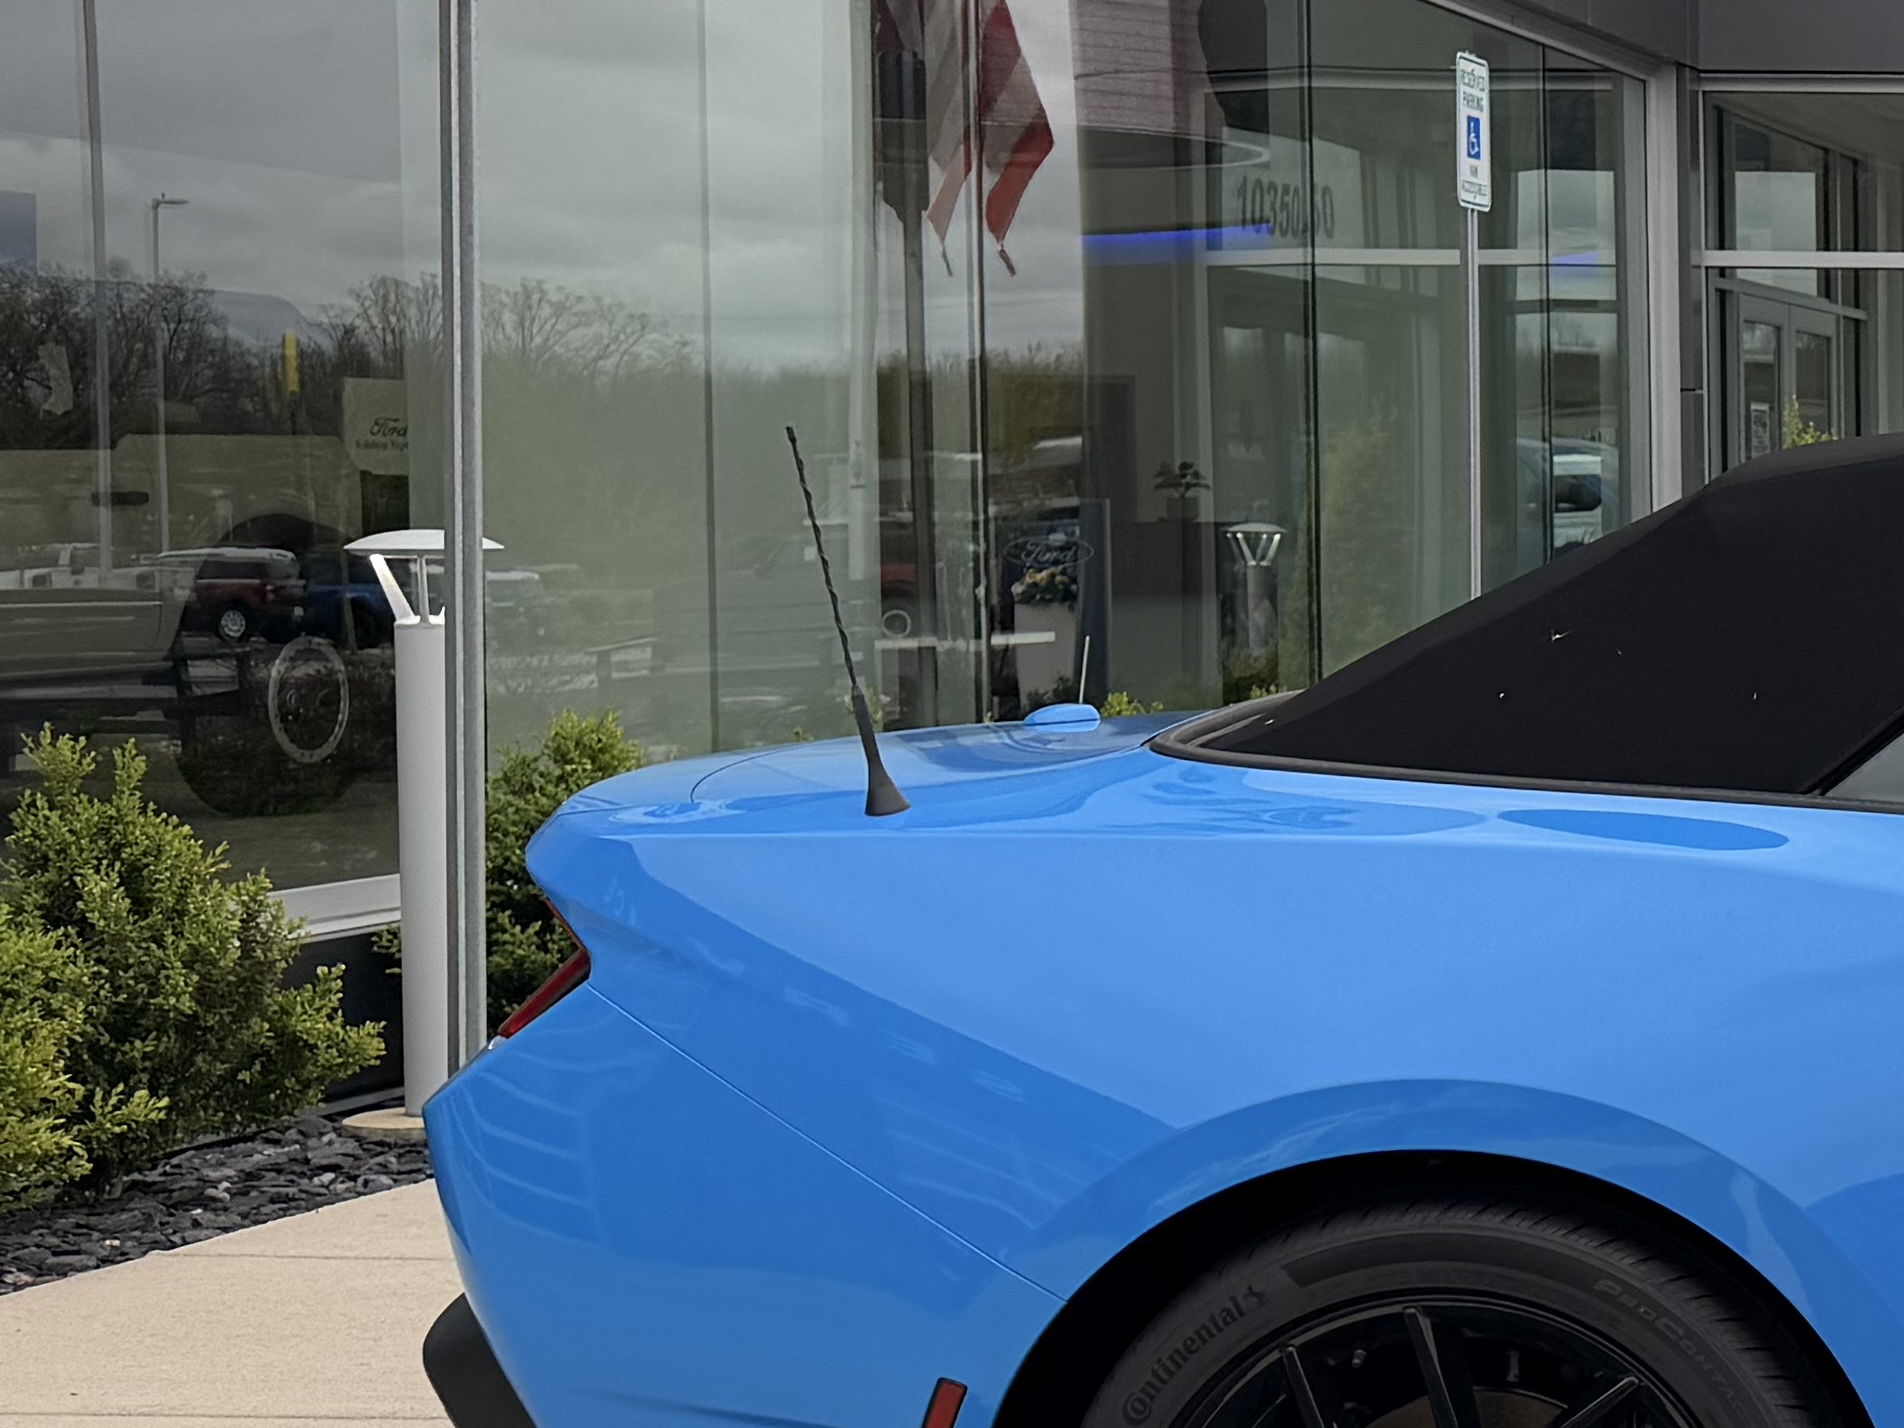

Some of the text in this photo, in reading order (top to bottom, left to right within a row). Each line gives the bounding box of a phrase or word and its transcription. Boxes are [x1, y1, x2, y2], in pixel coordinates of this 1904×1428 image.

[369, 417, 408, 437] Ford
[1020, 540, 1076, 562] Ford
[1121, 1294, 1246, 1427] Continental
